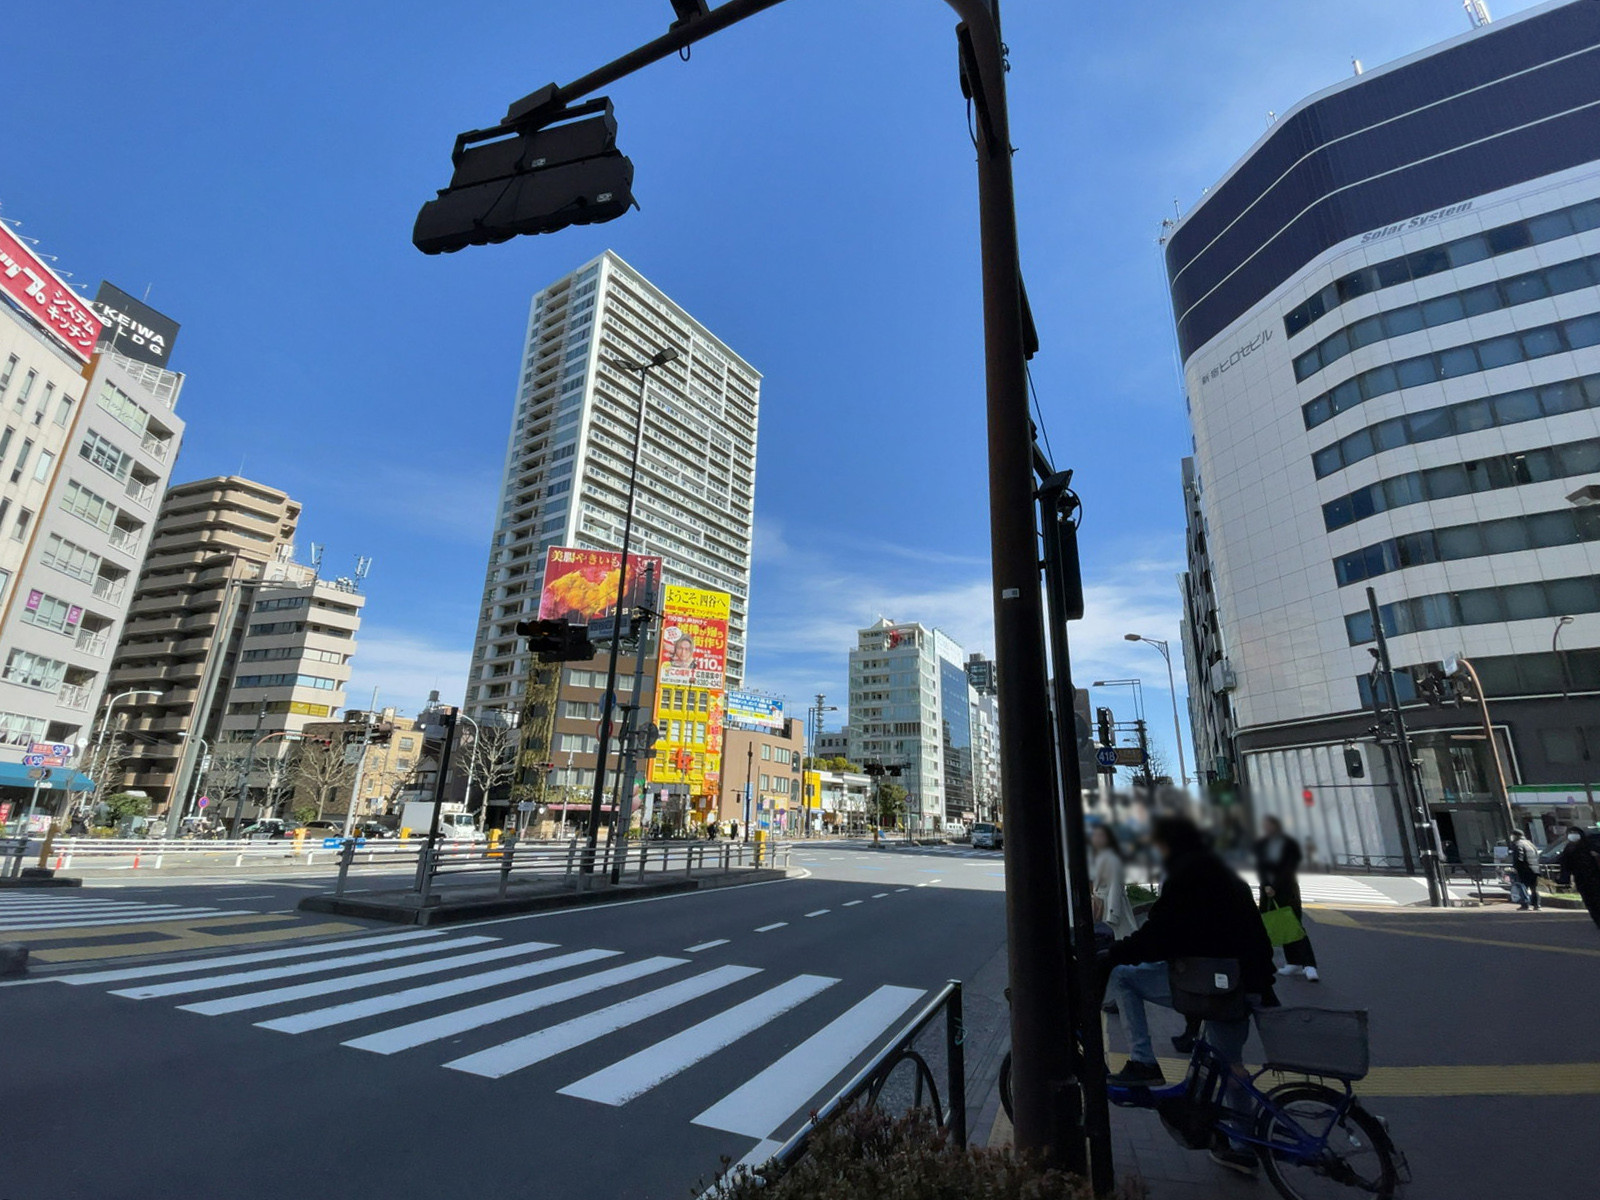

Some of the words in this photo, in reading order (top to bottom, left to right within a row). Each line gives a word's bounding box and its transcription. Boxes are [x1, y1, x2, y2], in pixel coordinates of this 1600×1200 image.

[1361, 222, 1406, 243] Solar
[1408, 201, 1473, 229] System
[47, 305, 92, 346] キッチン
[52, 290, 94, 335] システム
[103, 305, 165, 347] KEIWA
[1202, 329, 1273, 385] 新宿ヒロセビル
[54, 746, 64, 754] 20
[1099, 751, 1116, 762] 418
